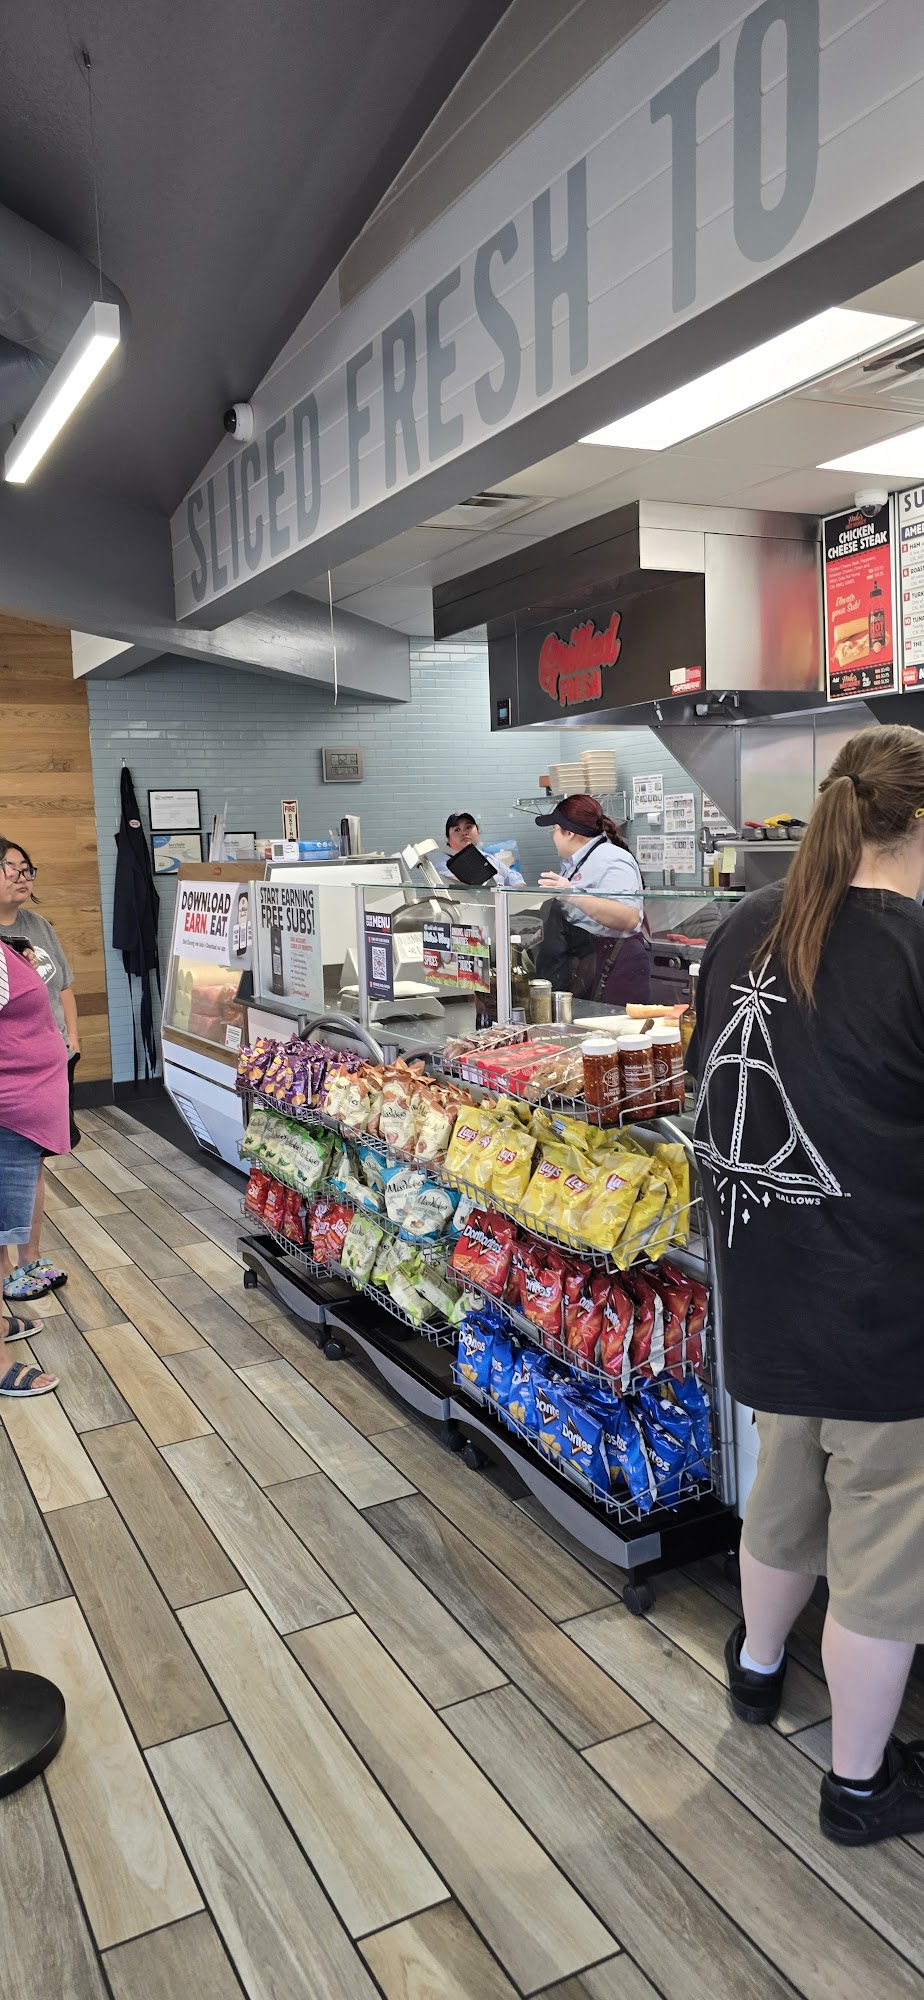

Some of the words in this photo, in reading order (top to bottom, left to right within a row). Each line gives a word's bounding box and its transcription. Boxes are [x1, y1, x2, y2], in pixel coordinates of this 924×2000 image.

[187, 393, 322, 604] SLICED
[347, 156, 589, 510] FRESH
[649, 0, 820, 314] TO
[838, 522, 875, 544] CHICKEN
[827, 541, 859, 559] CHEESE
[860, 530, 888, 550] STEAK
[284, 805, 296, 813] FIRE
[260, 886, 280, 905] START
[281, 888, 315, 909] EARNING
[184, 912, 208, 935] EARN.
[210, 914, 228, 938] EAT.
[261, 904, 284, 931] FREE
[286, 907, 316, 936] SUBS!
[372, 915, 391, 929] MENU
[424, 954, 439, 967] SPICES
[538, 1160, 563, 1178] Lay's
[775, 1192, 821, 1206] HALLOWS
[562, 1422, 594, 1456] Doritos
